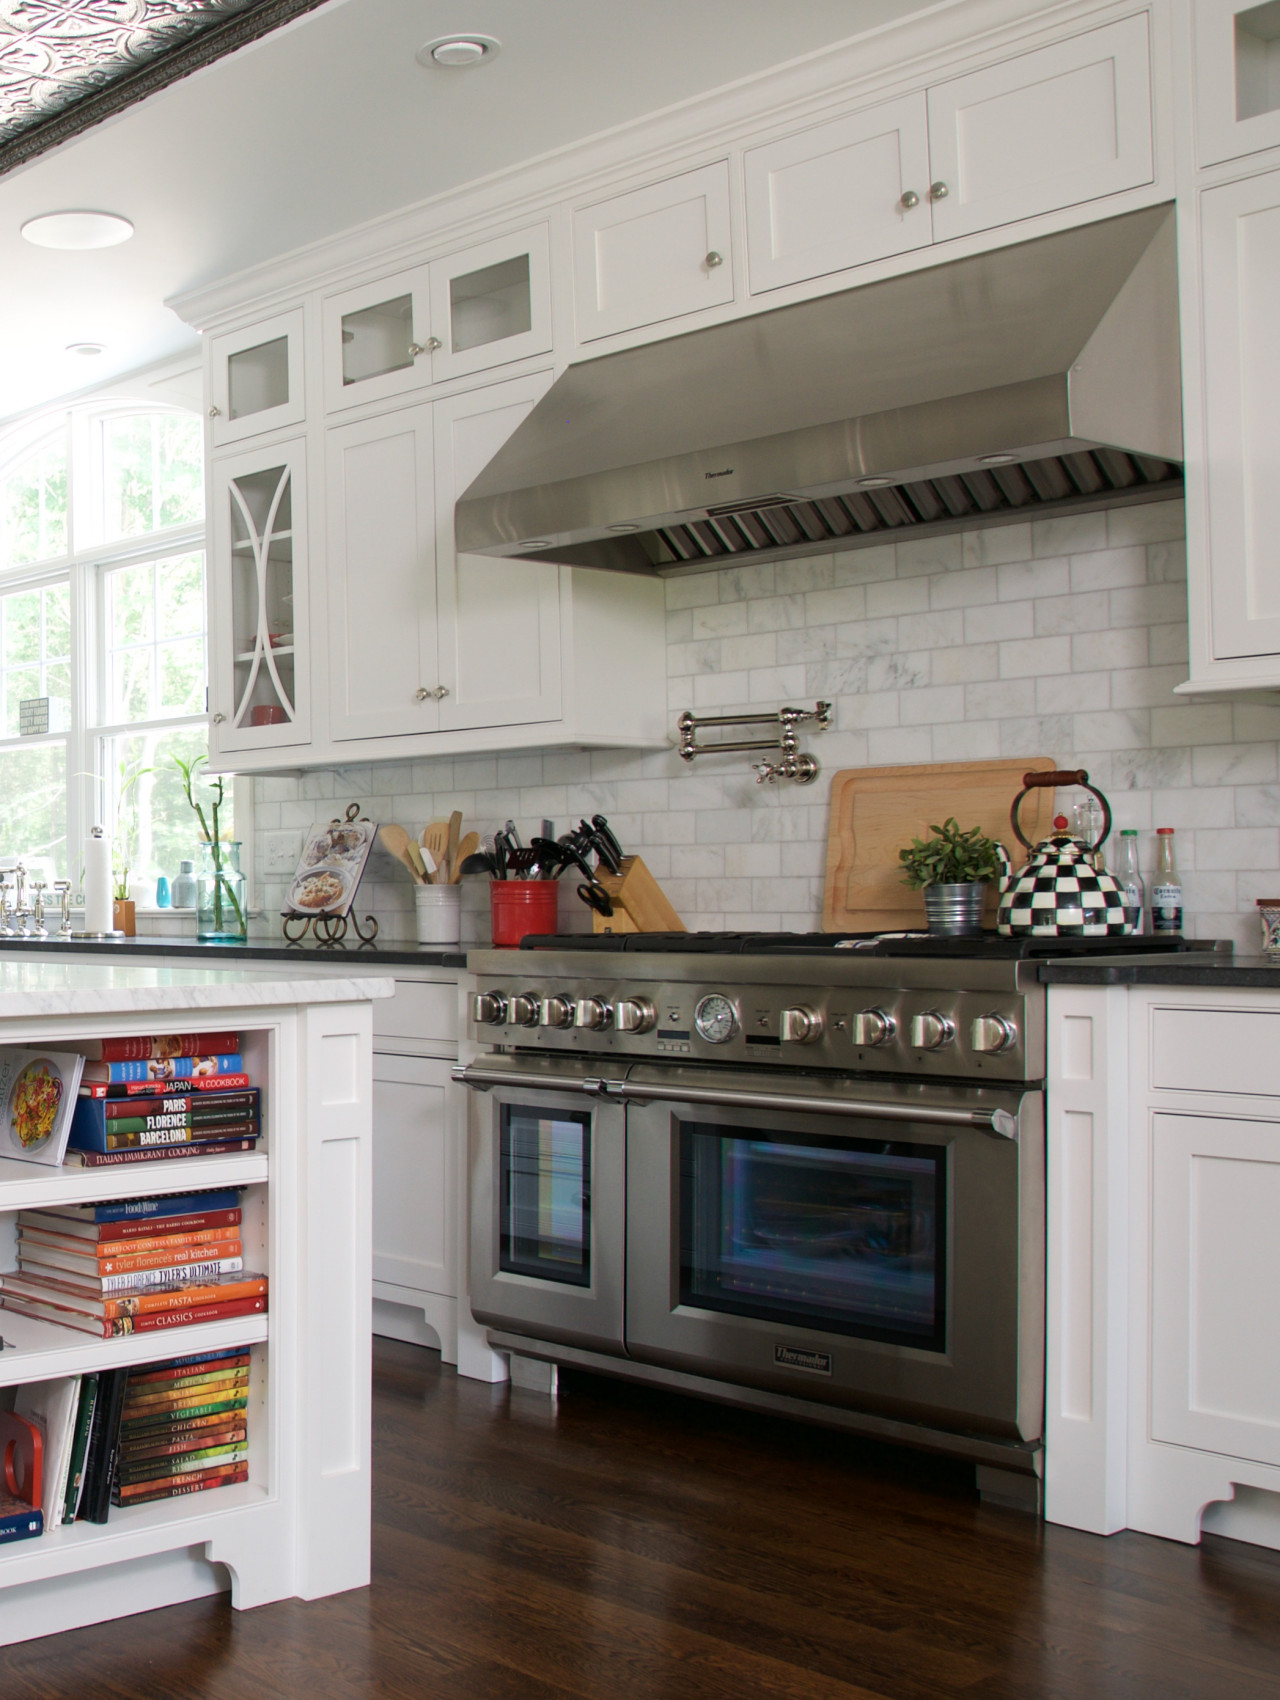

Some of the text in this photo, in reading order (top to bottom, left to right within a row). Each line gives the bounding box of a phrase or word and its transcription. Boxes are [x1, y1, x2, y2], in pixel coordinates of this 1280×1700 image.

[31, 894, 53, 905] KSS
[54, 894, 73, 905] TE
[163, 1080, 192, 1093] JAPAN
[206, 1078, 245, 1088] COOKBOOK
[163, 1098, 186, 1112] PARIS
[146, 1113, 186, 1129] FLORENCE
[140, 1128, 186, 1145] BARCELONA
[96, 1154, 123, 1164] ITALIAN
[124, 1150, 166, 1162] IMMIGRANT
[168, 1146, 200, 1158] COOKING
[104, 1234, 212, 1254] BAREFOOT CONTESSA FAMILY STYLE
[116, 1247, 218, 1270] tyler florence's real kitchen
[107, 1262, 221, 1291] TYLER FLORENCE TYLER'S ULTIMATE
[169, 1296, 192, 1306] PASTA
[156, 1312, 192, 1326] CLASSICS
[776, 1347, 828, 1366] Thermador
[174, 1366, 205, 1376] ITALIAN
[174, 1377, 208, 1388] MEXICAN
[170, 1406, 213, 1419] VEGETABLE
[172, 1420, 208, 1432] CHICKEN
[172, 1434, 194, 1443] PASTA
[169, 1445, 186, 1453] FISH
[172, 1455, 195, 1464] SALAD
[172, 1474, 202, 1485] FRENCH
[172, 1484, 204, 1496] DESSERT
